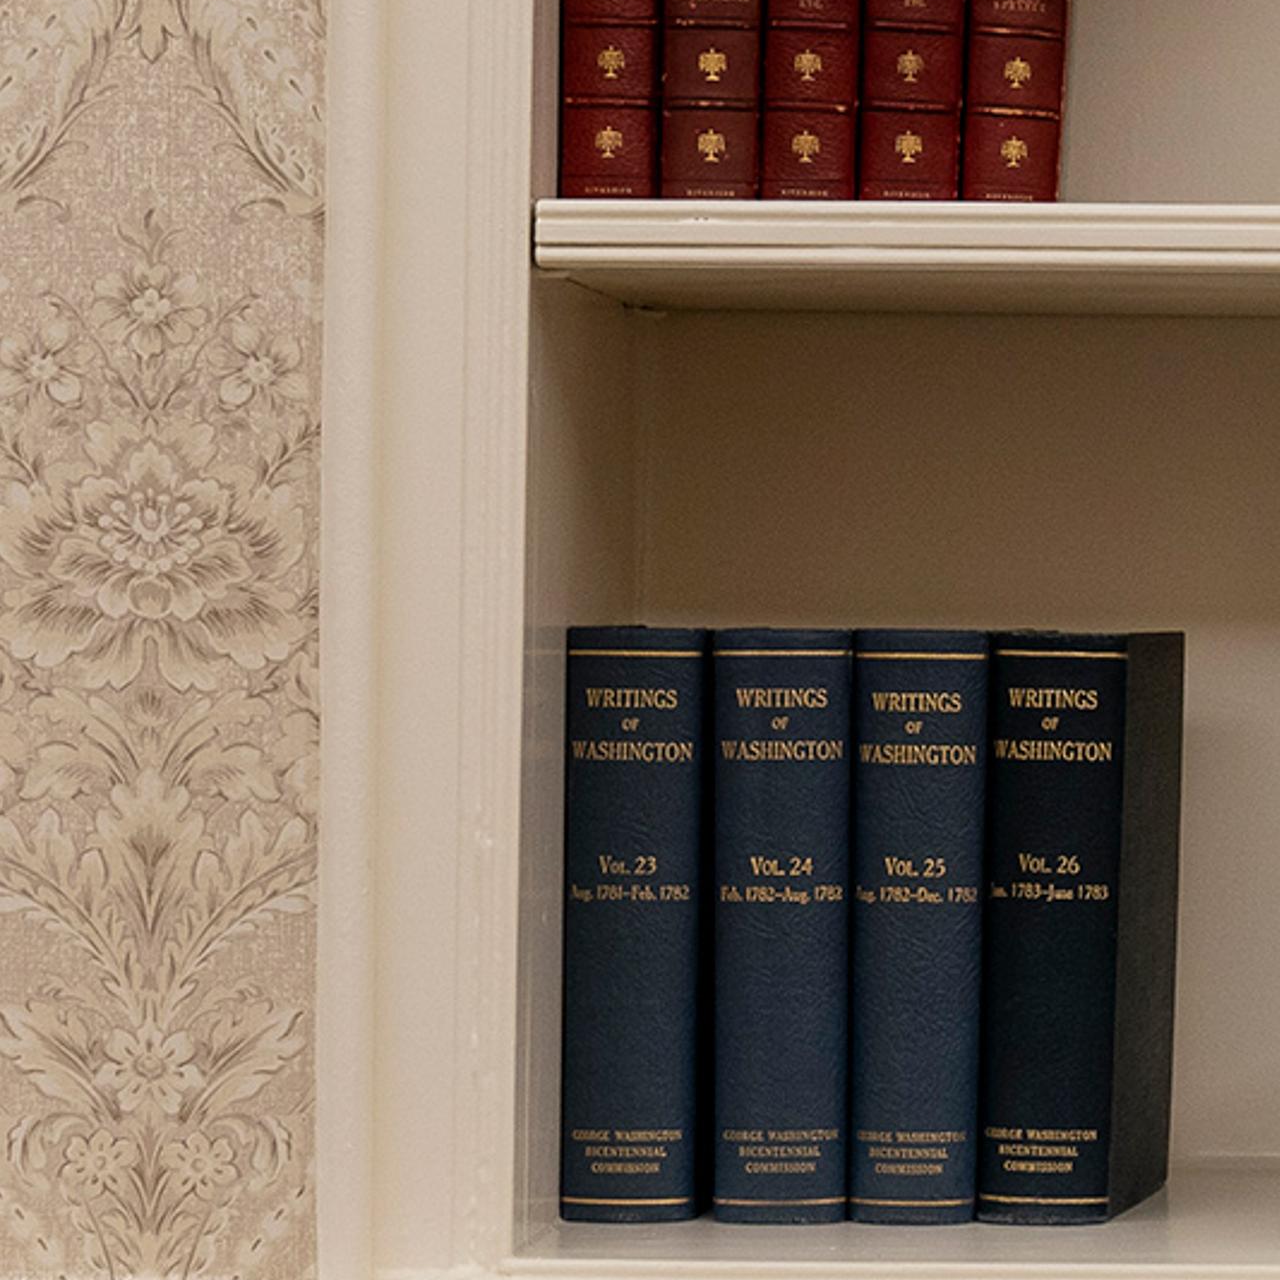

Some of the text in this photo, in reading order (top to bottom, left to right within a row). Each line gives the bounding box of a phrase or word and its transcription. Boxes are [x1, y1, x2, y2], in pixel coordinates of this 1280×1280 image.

[586, 687, 678, 710] WRITINGS
[735, 687, 829, 709] WRITINGS
[872, 692, 963, 713] WRITINGS
[1008, 687, 1098, 710] WRITINGS
[621, 717, 640, 731] OF
[771, 716, 789, 730] OF
[904, 720, 923, 735] OF
[1041, 716, 1060, 731] OF
[573, 740, 694, 763] WASHINGTON
[721, 740, 843, 761] WASHINGTON
[862, 744, 977, 766] WASHINGTON
[996, 739, 1112, 762] WASHINGTON
[634, 855, 657, 875] 23
[789, 856, 813, 876] 24
[922, 857, 947, 878] 25
[1056, 855, 1081, 875] 26
[1077, 884, 1109, 901] 1783
